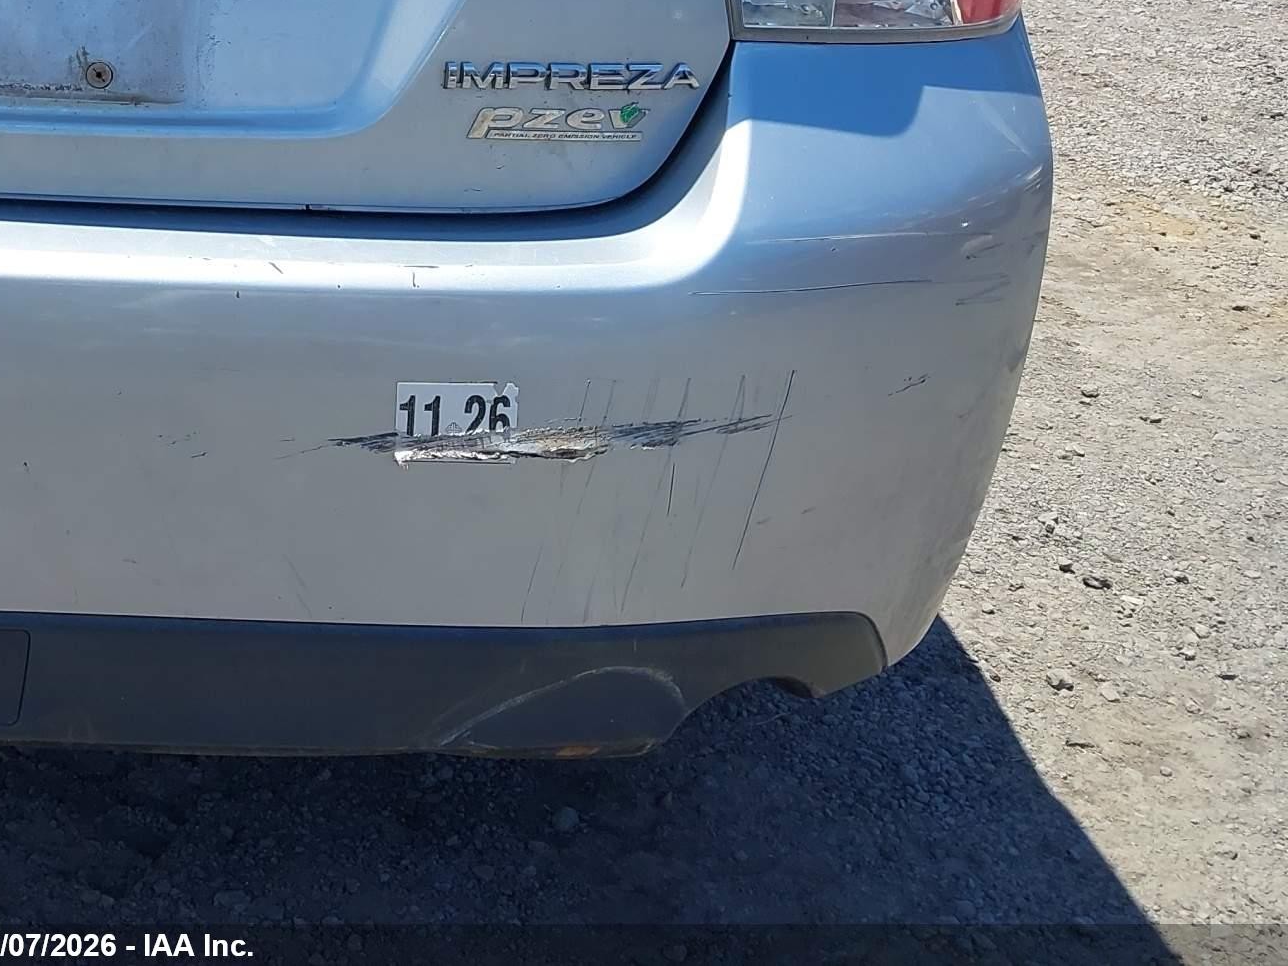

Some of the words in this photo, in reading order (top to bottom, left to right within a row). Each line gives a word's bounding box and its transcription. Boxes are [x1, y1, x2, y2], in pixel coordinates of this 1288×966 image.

[443, 61, 700, 90] IMPREZA
[400, 395, 441, 436] 11
[464, 395, 511, 435] 26
